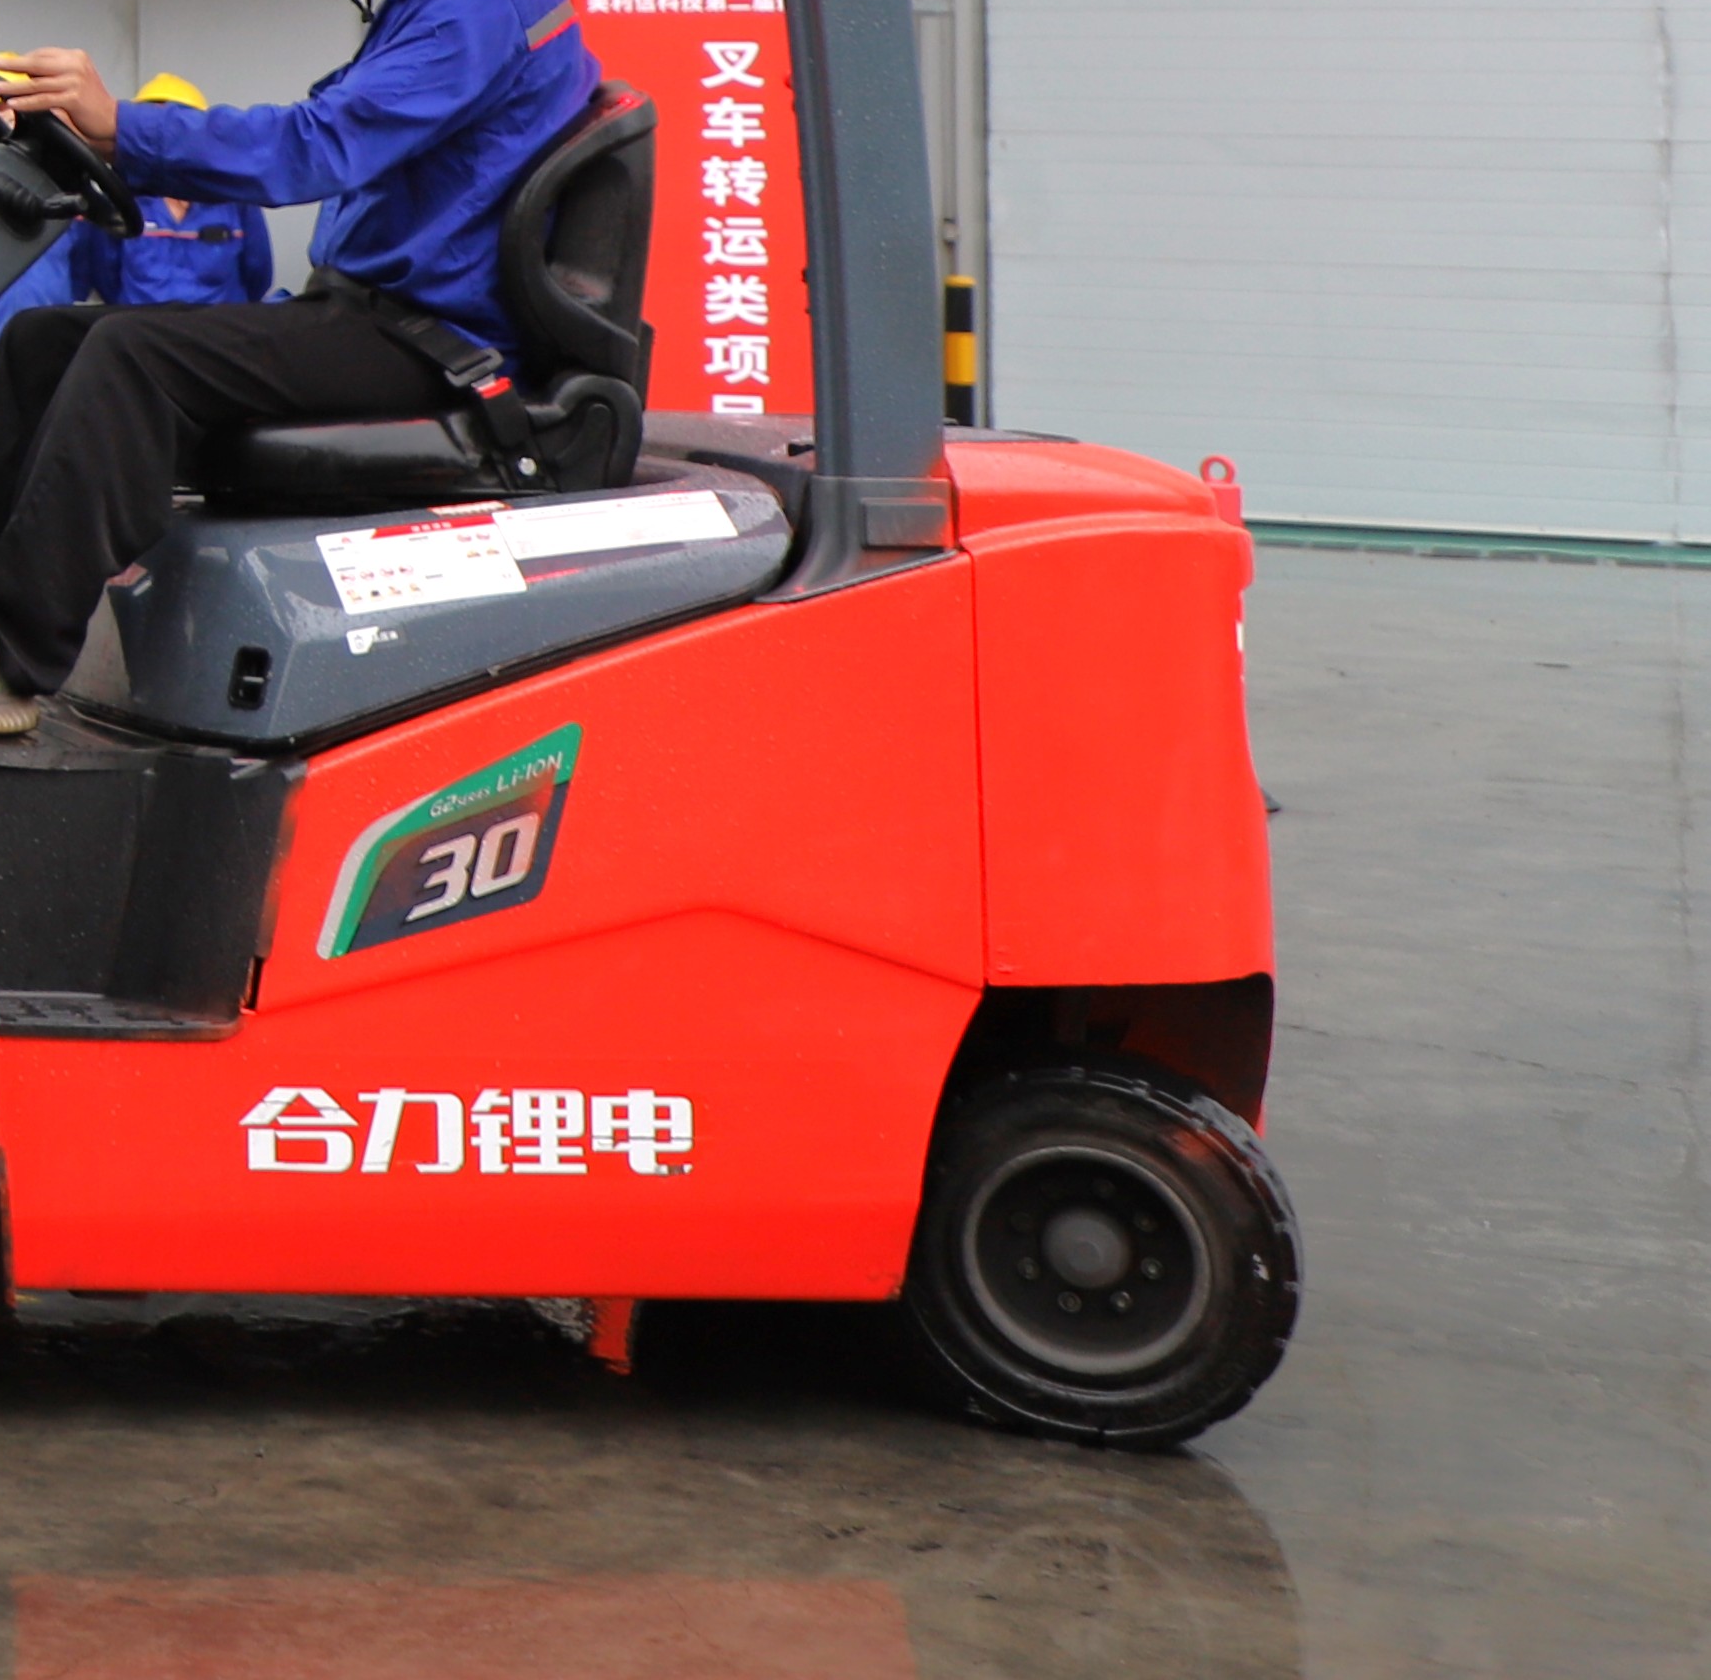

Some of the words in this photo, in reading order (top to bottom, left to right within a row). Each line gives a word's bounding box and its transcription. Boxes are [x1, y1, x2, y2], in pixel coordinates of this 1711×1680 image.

[405, 811, 540, 921] 30
[239, 1086, 694, 1176] 合力锂电
